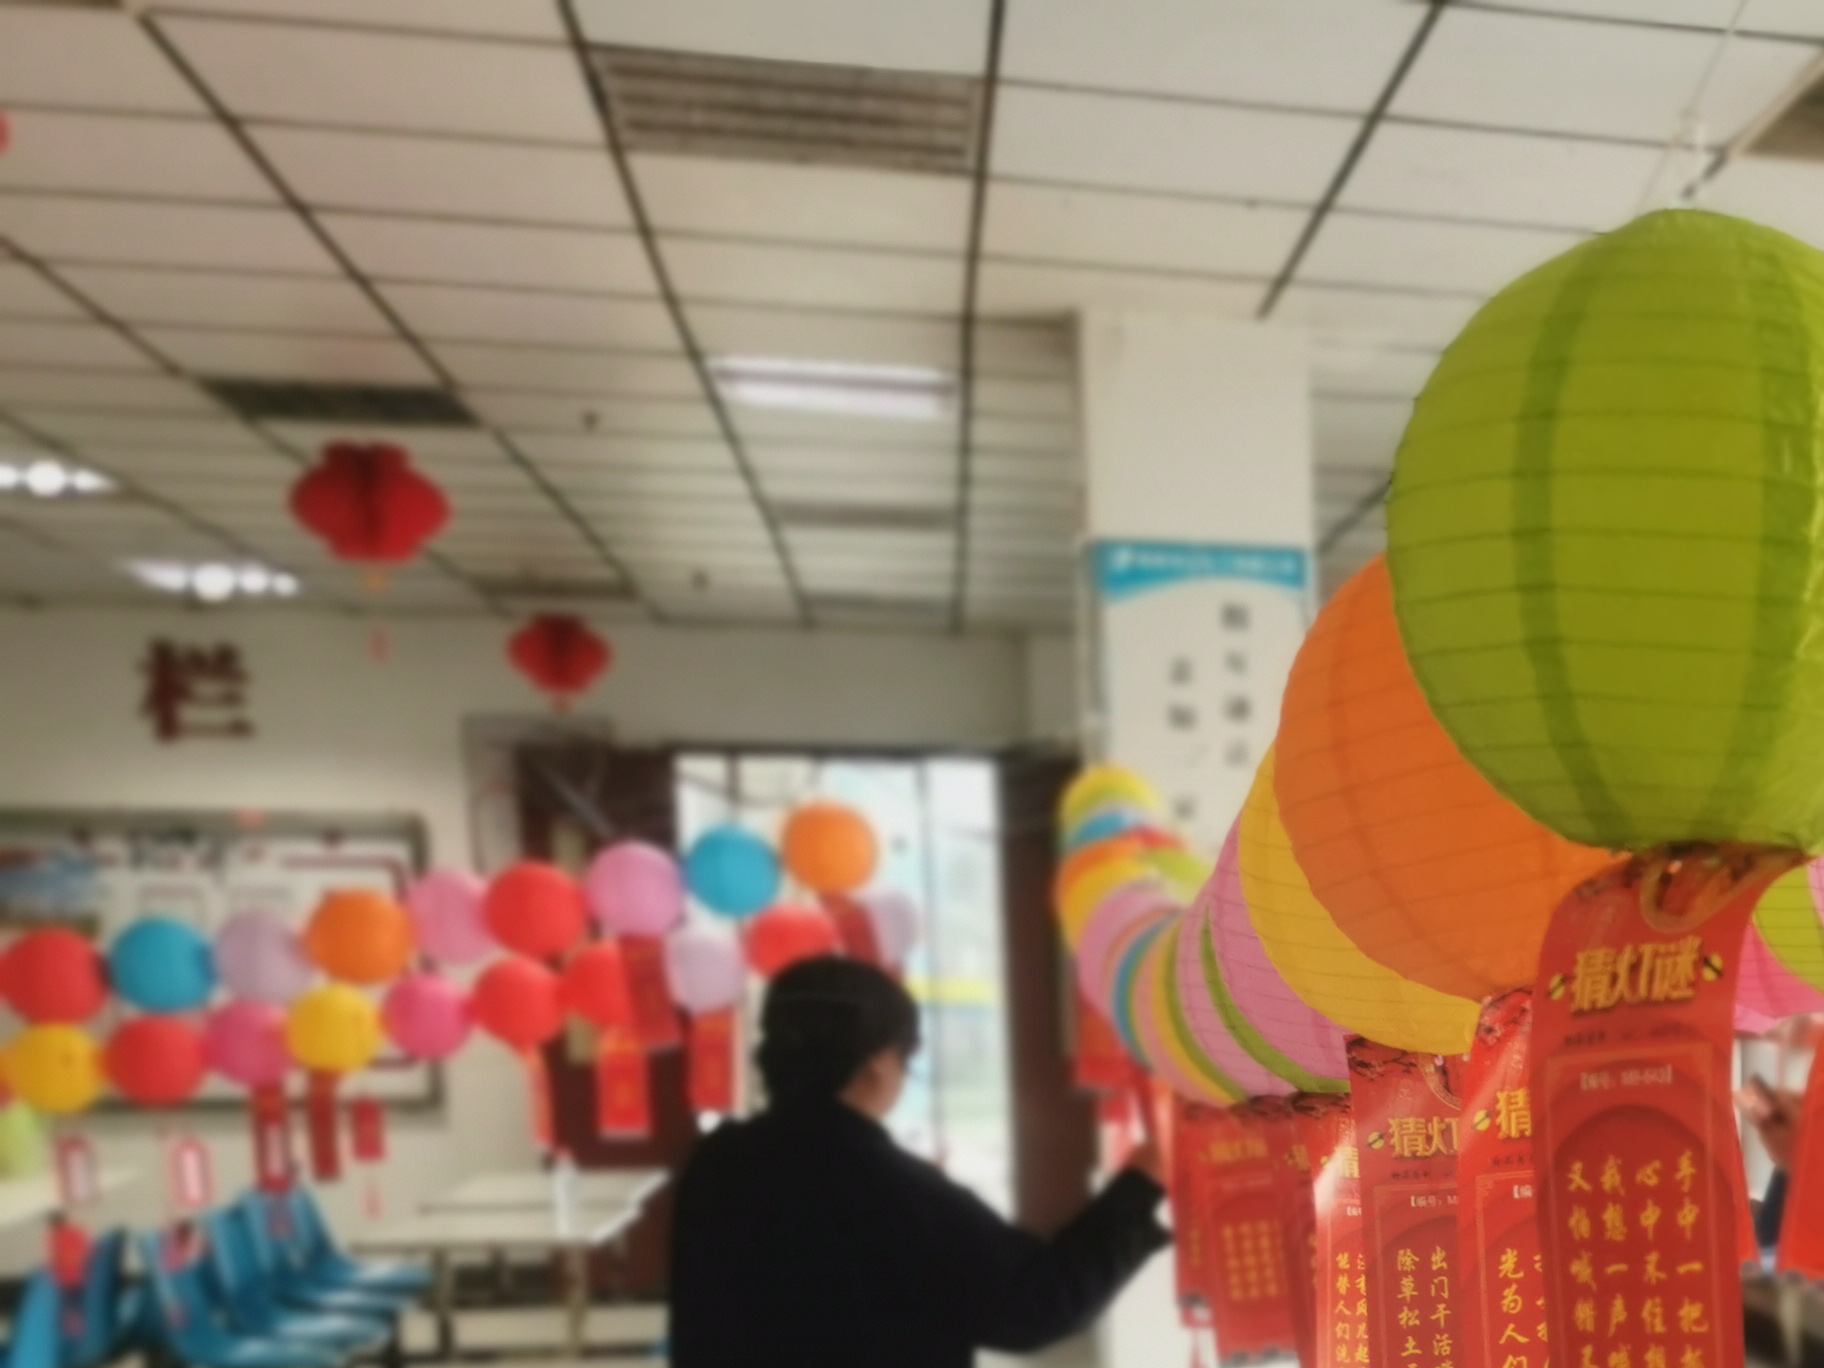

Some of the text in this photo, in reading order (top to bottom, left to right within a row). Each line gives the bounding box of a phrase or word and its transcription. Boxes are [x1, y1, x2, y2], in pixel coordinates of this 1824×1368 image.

[134, 636, 256, 744] 栏
[1571, 934, 1702, 1014] 猜灯谜
